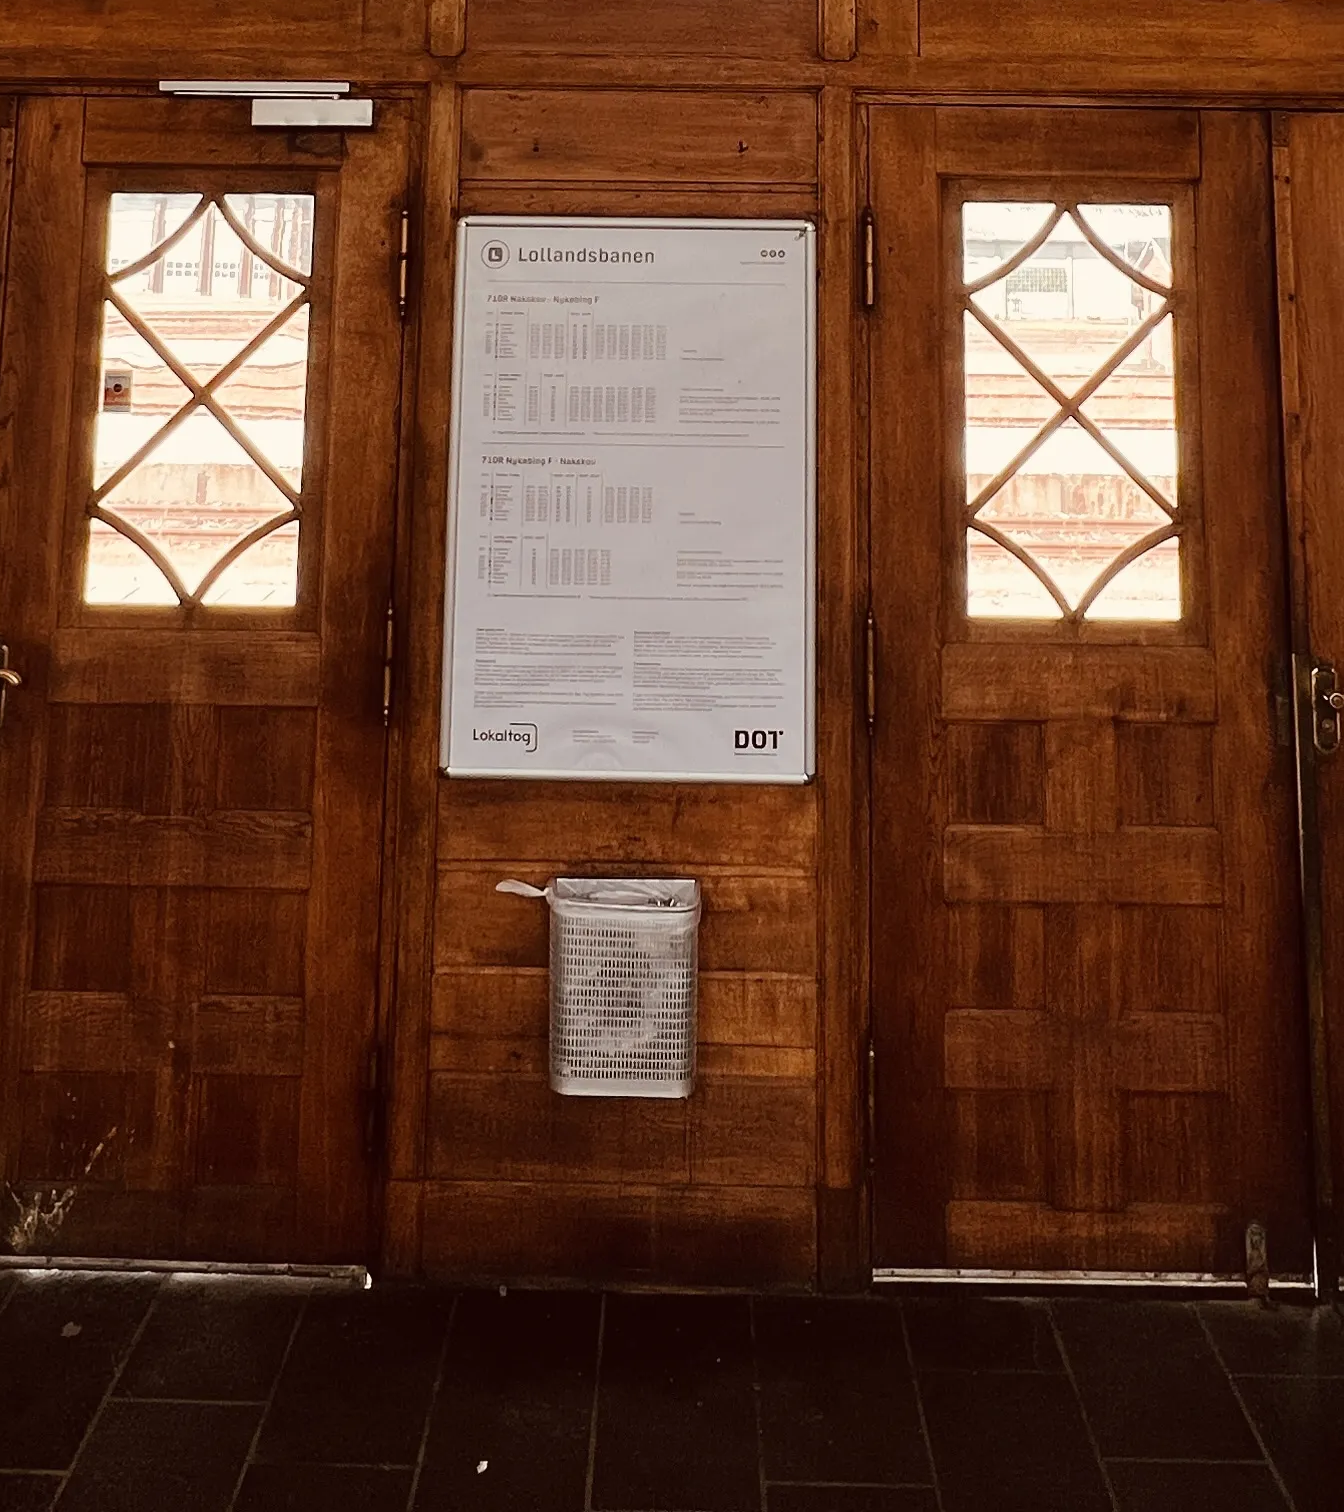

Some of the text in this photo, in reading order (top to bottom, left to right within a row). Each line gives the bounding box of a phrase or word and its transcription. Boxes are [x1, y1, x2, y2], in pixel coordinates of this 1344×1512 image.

[518, 247, 655, 264] Lollandsbanen
[486, 294, 508, 303] 710R
[481, 455, 504, 464] 710R
[472, 728, 531, 746] Lokaltog
[734, 730, 778, 749] DOT
